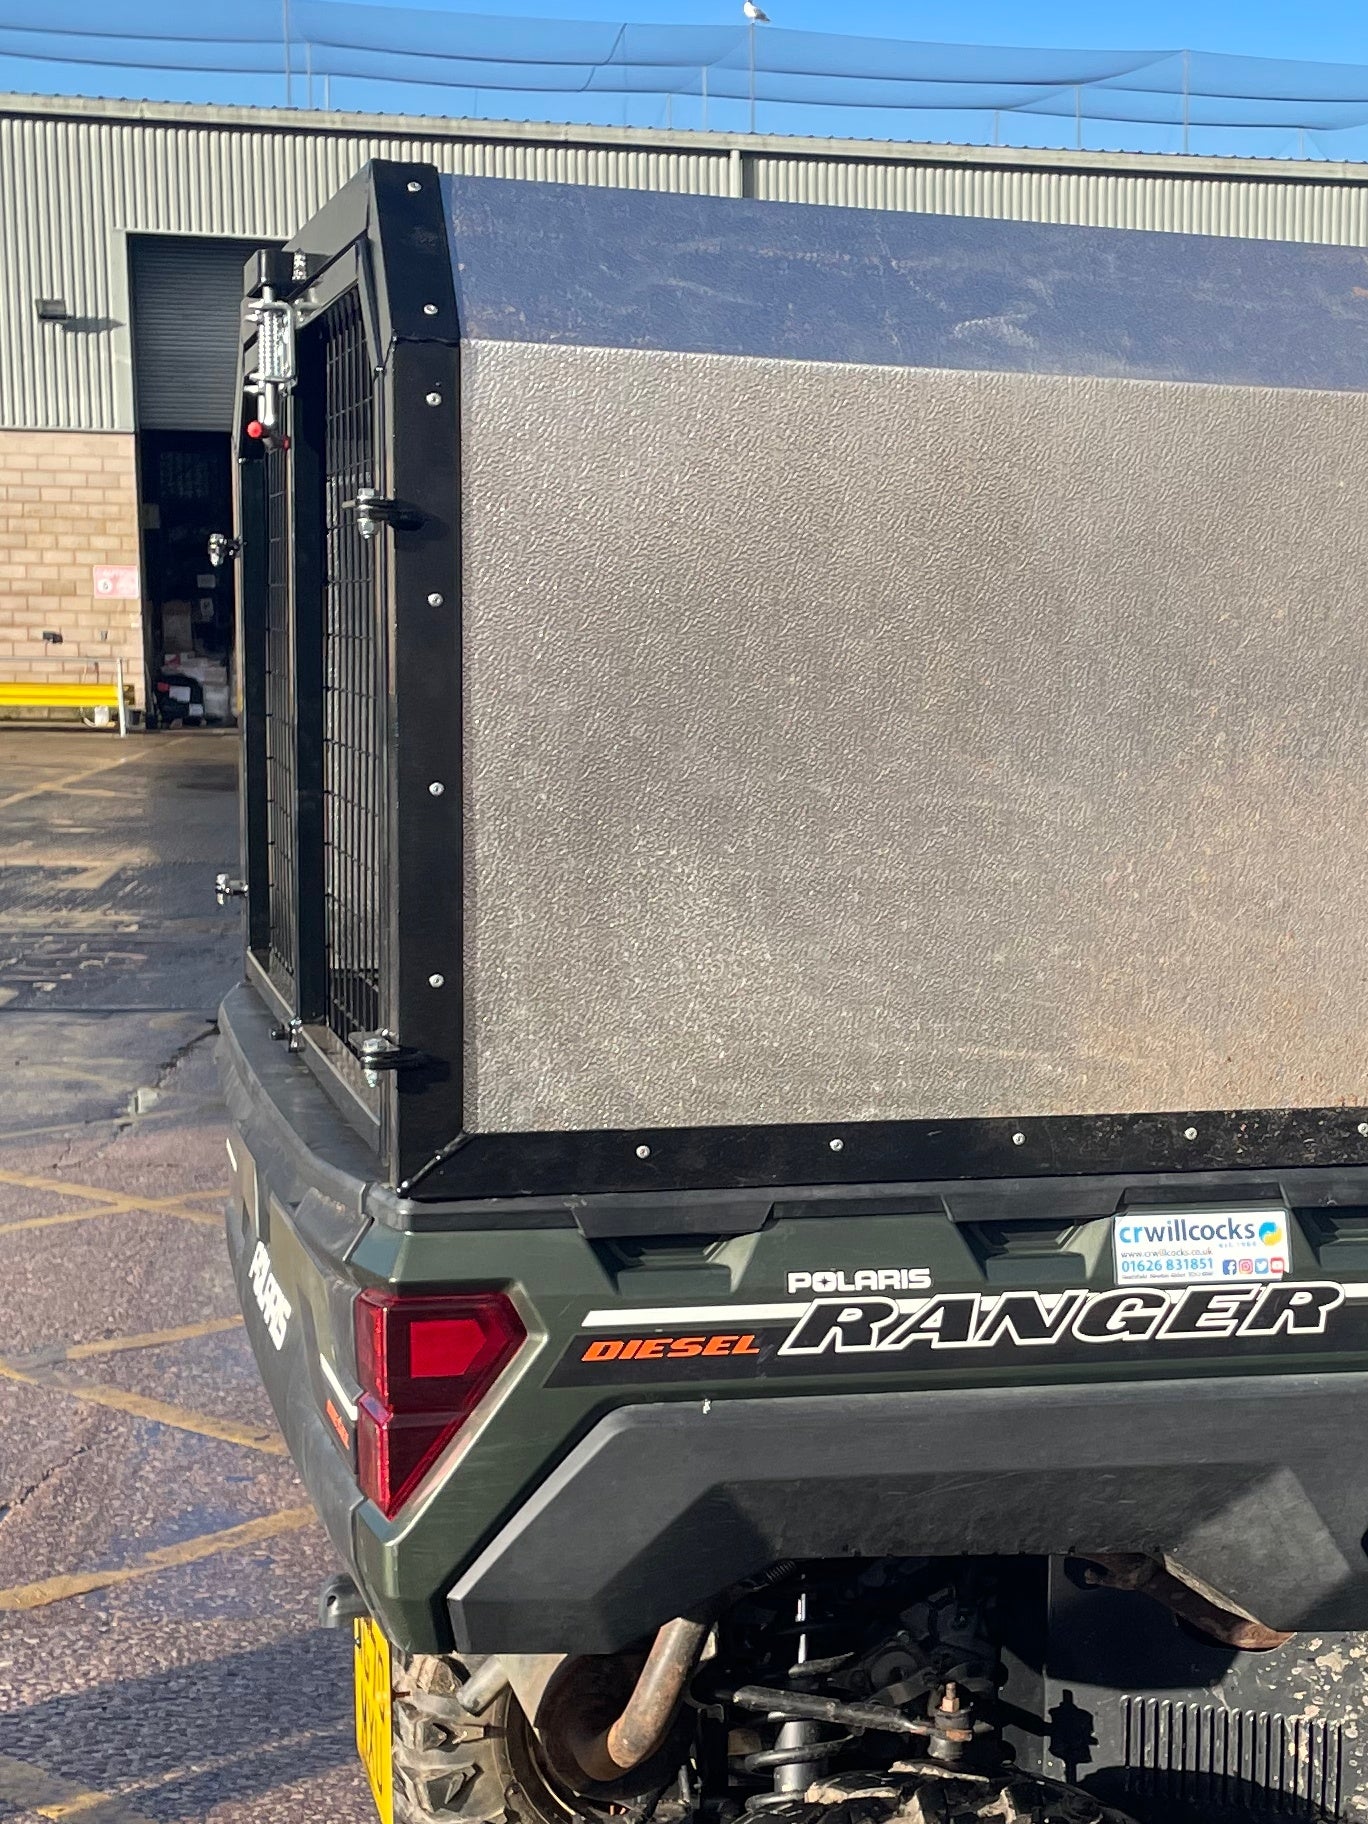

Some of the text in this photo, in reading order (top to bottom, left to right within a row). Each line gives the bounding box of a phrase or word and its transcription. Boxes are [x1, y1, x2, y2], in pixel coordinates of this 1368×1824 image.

[1118, 1216, 1255, 1244] crwillcocks
[1121, 1257, 1214, 1273] 01626 831851
[787, 1268, 932, 1294] POLARIS
[777, 1281, 1346, 1356] RANGER
[581, 1335, 760, 1362] DIESEL
